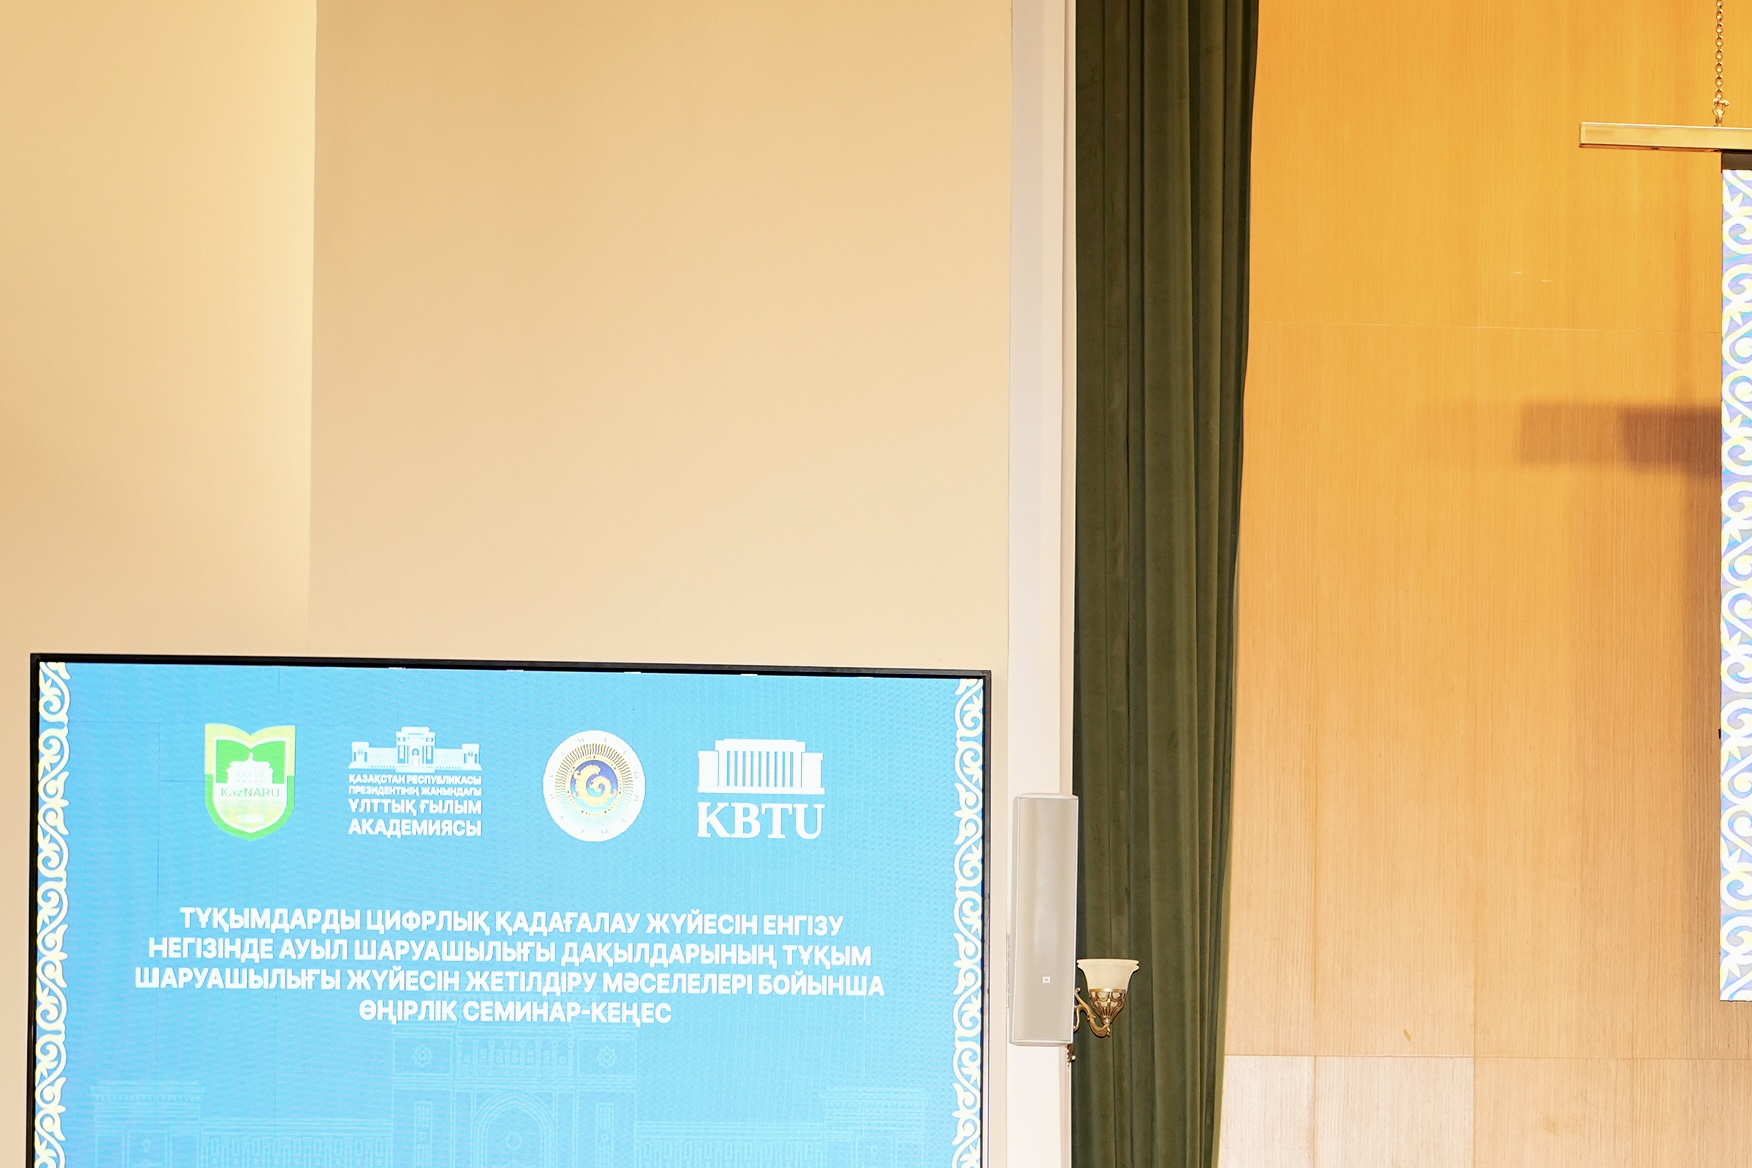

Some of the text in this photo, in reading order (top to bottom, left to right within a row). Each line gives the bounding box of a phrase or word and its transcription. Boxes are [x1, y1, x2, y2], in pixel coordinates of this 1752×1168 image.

[220, 787, 280, 797] KazNARU
[406, 775, 482, 785] РЕСПУБЛИКАСЫ
[348, 798, 482, 817] ҰЛТТЫҚ ҒЫЛЫМ
[697, 801, 826, 840] KBTU
[348, 818, 482, 838] АКАДЕМИЯСЫ
[180, 907, 844, 936] ТҰҚЫМДАРДЫ ЦИФРЛЫҚ ҚАДАҒАЛАУ ЖҮЙЕСІН ЕНГІЗУ
[149, 937, 872, 969] НЕГІЗІНДЕ АУЫЛ ШАРУАШЫЛЫҒЫ ДАҚЫЛДАРЫНЫҢ ТҰҚЫМ
[135, 966, 885, 997] ШАРУАШЫЛЫҒЫ ЖҮЙЕСІН ЖЕТІЛДІРУ МӘСЕЛЕЛЕРІ БОЙЫНША
[359, 999, 672, 1028] ӨҢІРЛІК СЕМИНАР-КЕҢЕС
